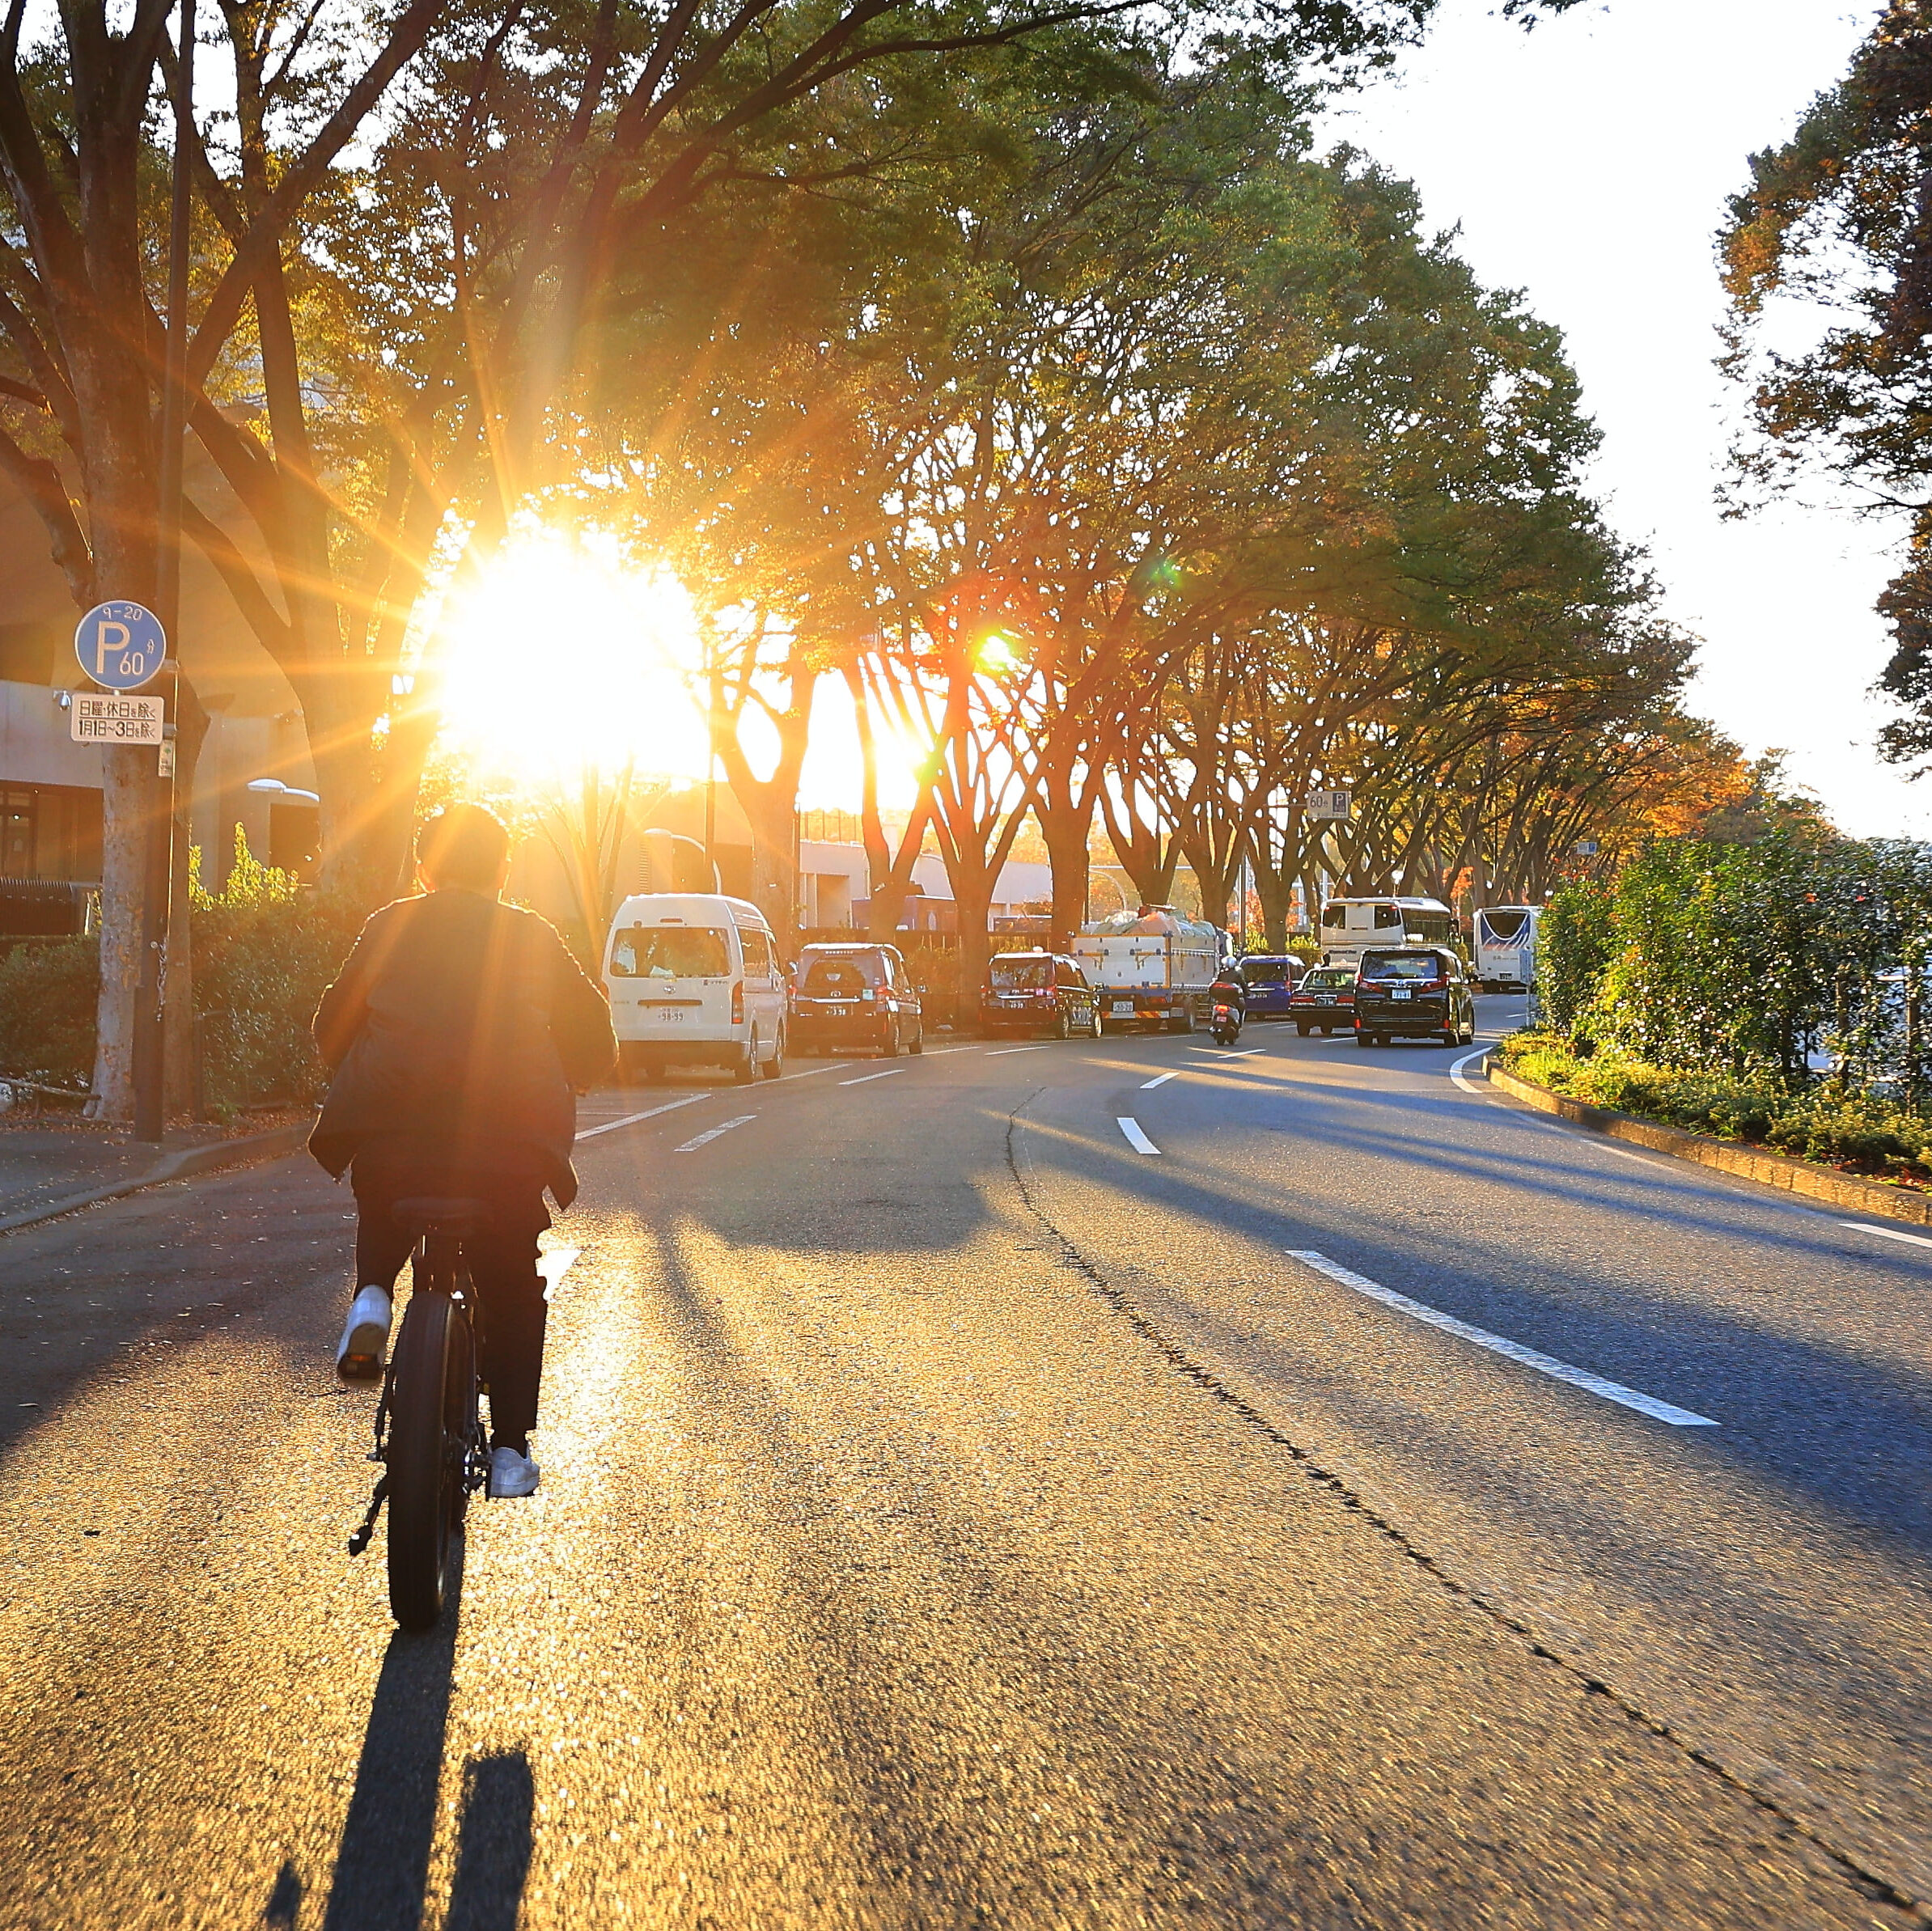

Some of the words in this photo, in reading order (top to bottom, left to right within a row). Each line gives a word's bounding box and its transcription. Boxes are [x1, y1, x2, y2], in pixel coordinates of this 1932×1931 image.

[96, 620, 130, 674] P
[119, 651, 144, 675] 60
[1336, 794, 1344, 806] P
